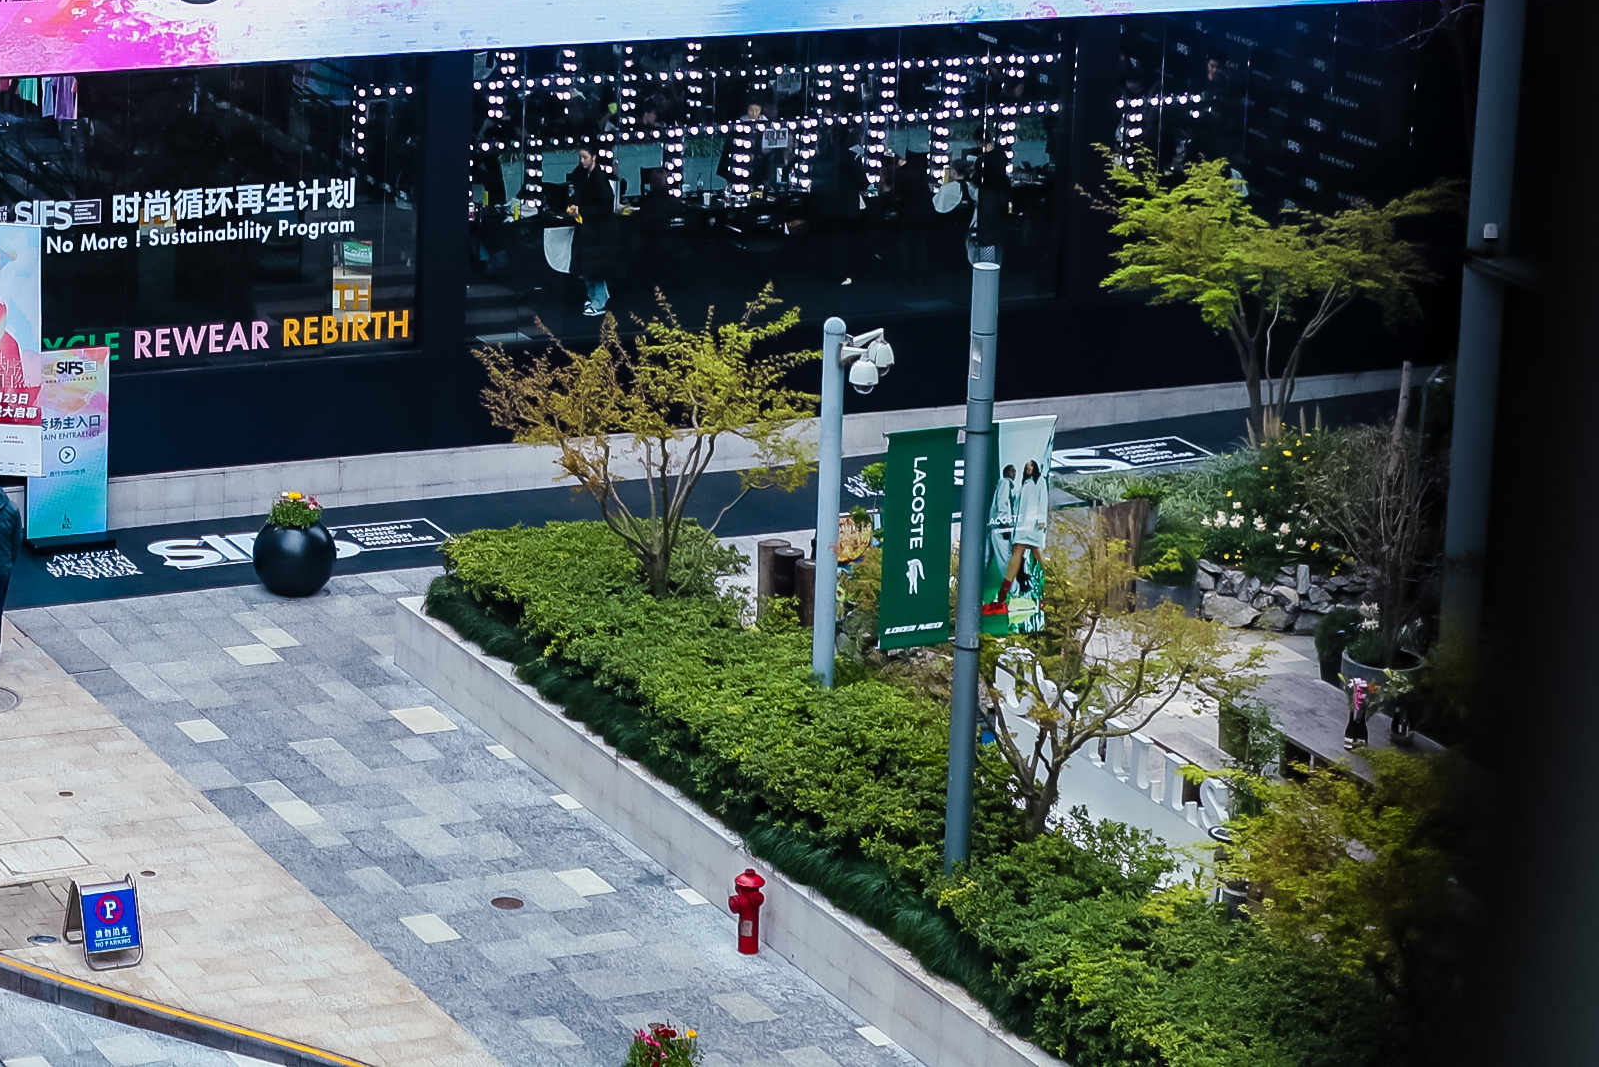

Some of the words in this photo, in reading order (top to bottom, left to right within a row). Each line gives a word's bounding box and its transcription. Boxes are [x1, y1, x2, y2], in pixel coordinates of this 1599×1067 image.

[14, 199, 74, 231] SIFS
[111, 176, 356, 225] 时尚循环再生计划
[46, 235, 74, 255] No
[80, 232, 128, 252] More
[148, 221, 273, 247] Sustainability
[278, 219, 356, 240] Program
[134, 320, 270, 360] REWEAR
[282, 309, 410, 348] REBIRTH
[55, 361, 84, 376] SIFS
[41, 433, 57, 441] AIN
[909, 456, 928, 550] LACOSTE
[103, 898, 117, 920] P
